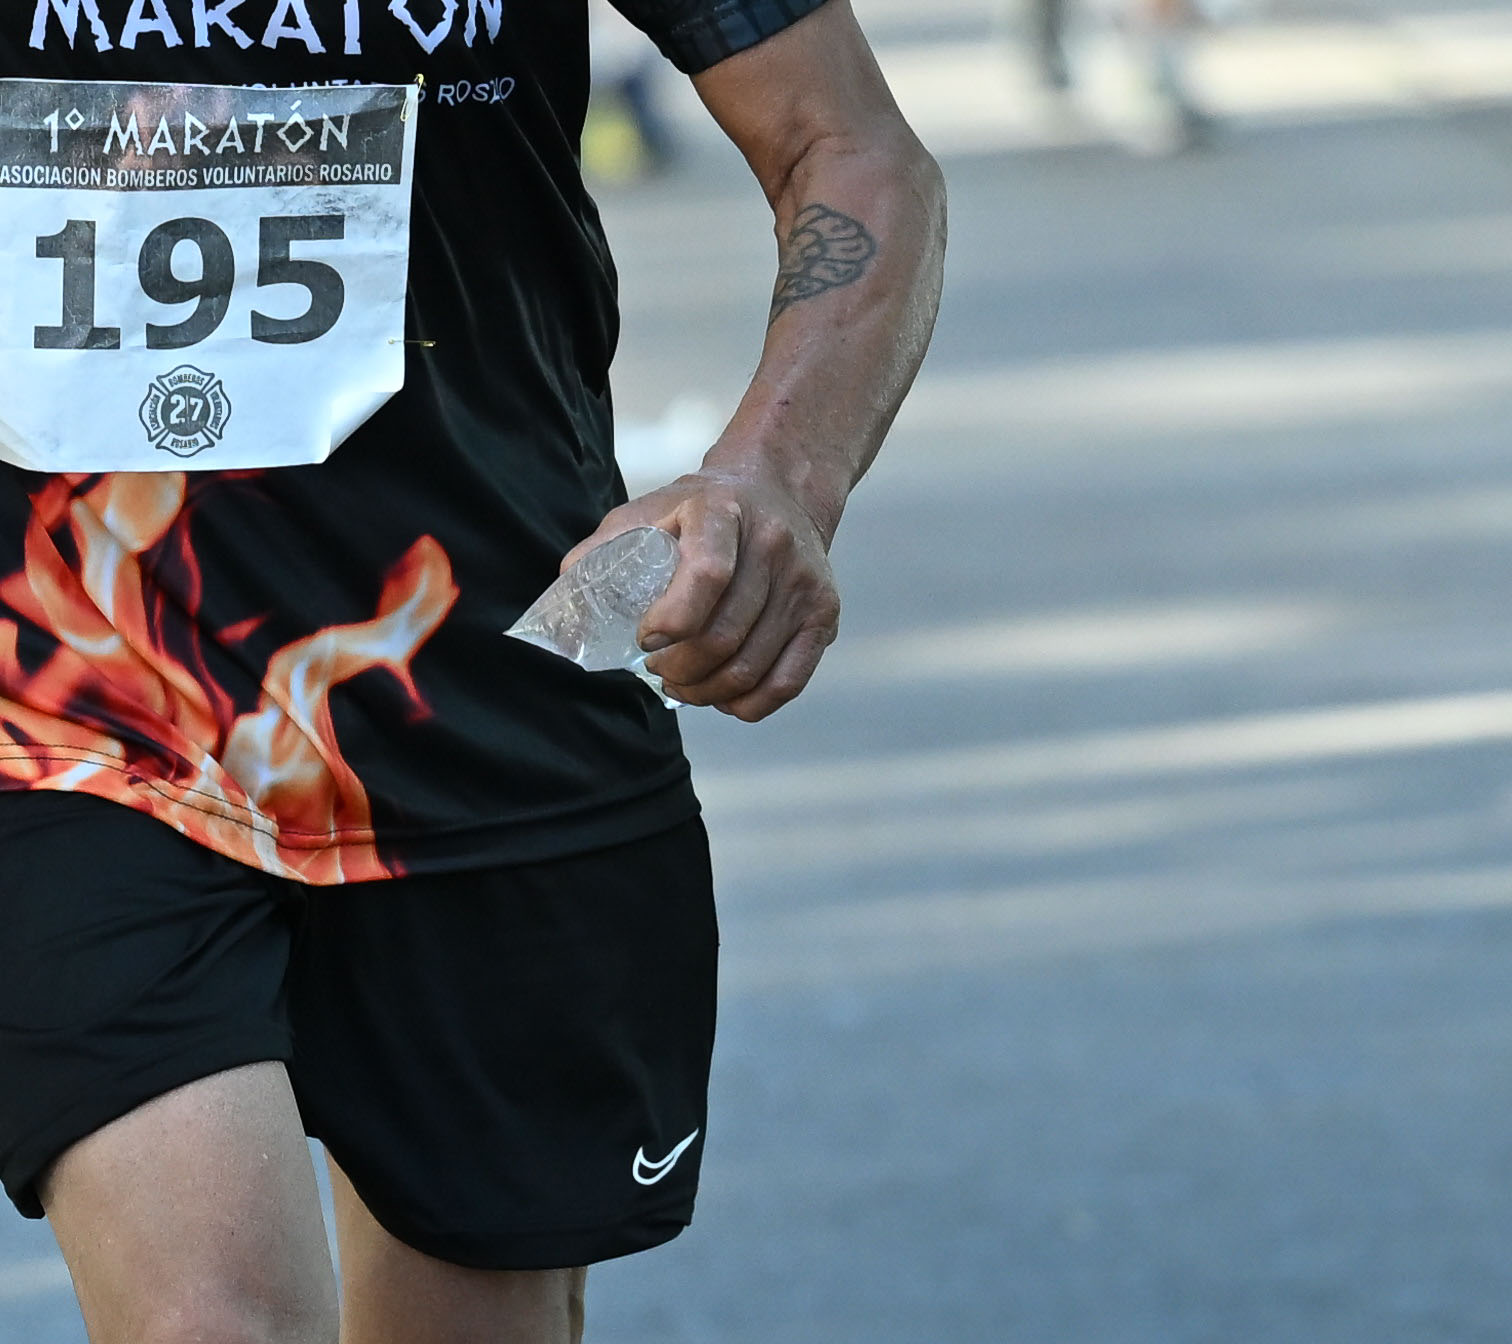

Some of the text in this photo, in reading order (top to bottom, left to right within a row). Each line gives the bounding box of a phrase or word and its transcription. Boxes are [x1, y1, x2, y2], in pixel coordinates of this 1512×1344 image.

[102, 99, 351, 156] MARATÓN
[105, 168, 198, 188] BOMBEROS
[202, 163, 314, 185] VOLUNTARIOS
[319, 162, 393, 182] ROSARIO
[33, 215, 346, 351] 195
[170, 394, 204, 425] 27
